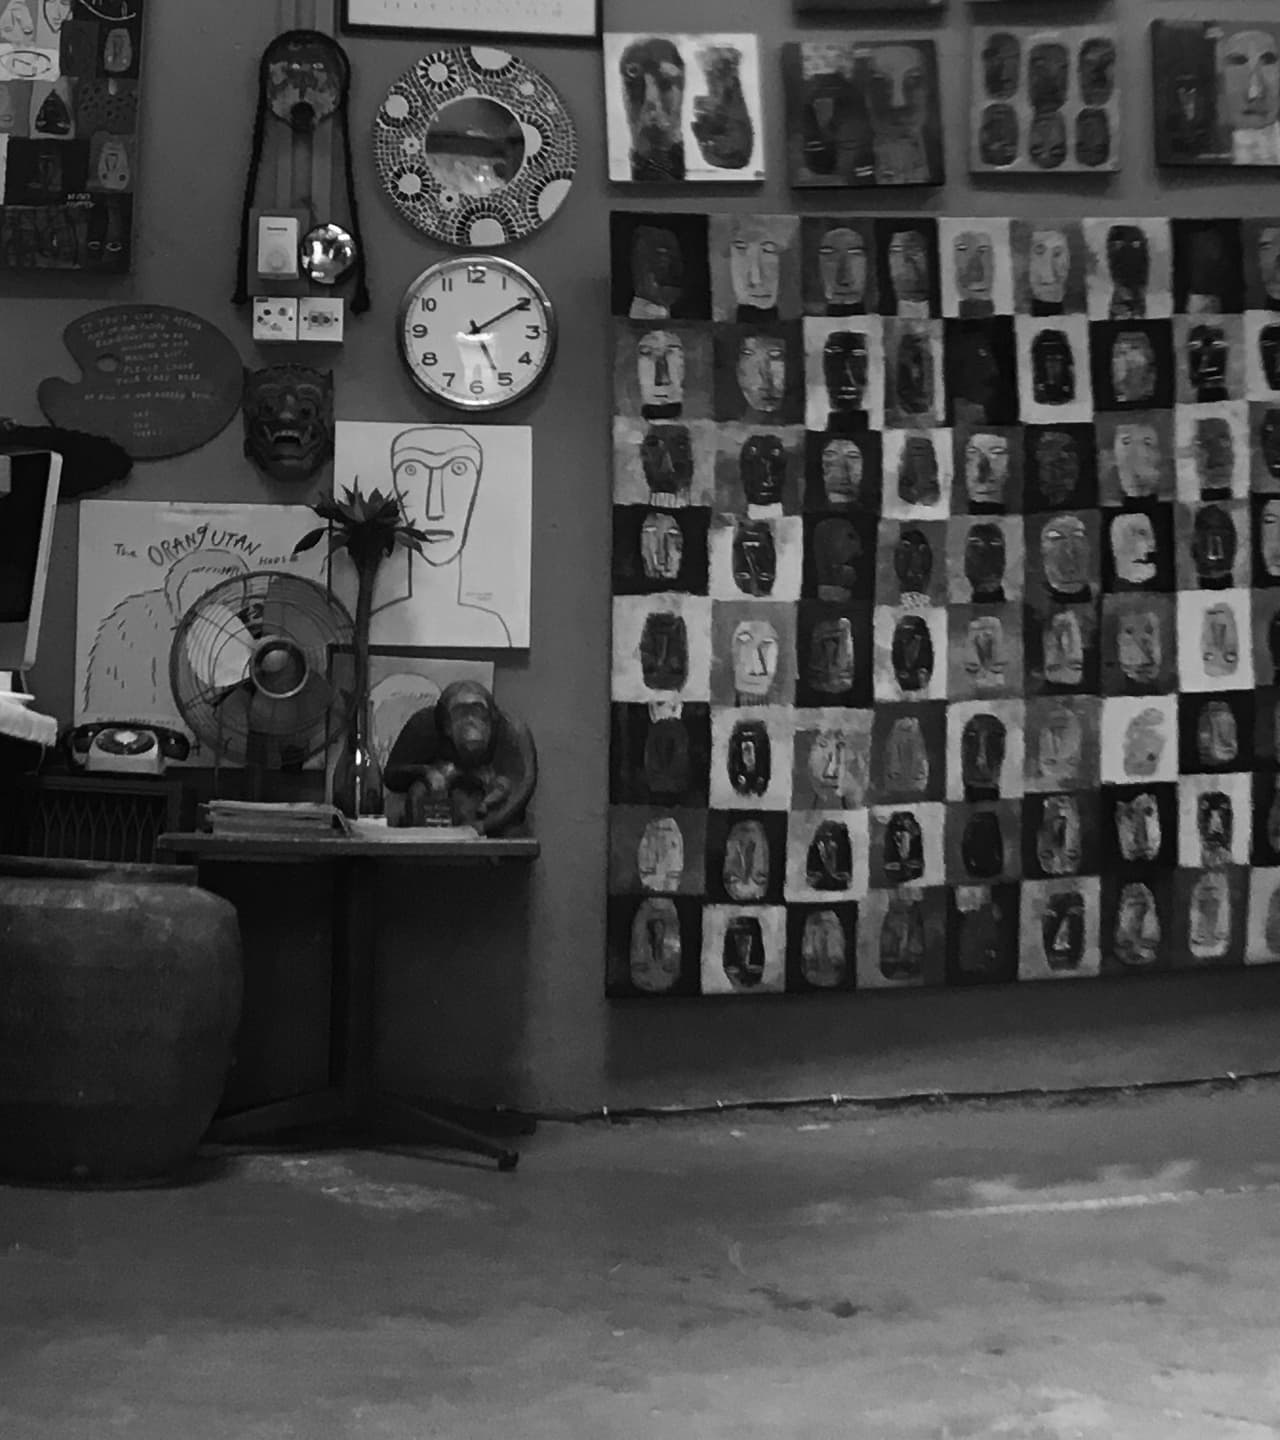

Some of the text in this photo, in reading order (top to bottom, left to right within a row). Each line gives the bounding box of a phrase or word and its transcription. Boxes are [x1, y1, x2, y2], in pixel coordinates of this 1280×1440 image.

[467, 269, 486, 284] 12
[441, 277, 453, 292] 11
[421, 297, 437, 312] 10
[517, 297, 531, 312] 2
[411, 324, 428, 339] 9
[525, 325, 541, 340] 3
[421, 351, 438, 366] 8
[517, 351, 533, 365] 4
[441, 372, 456, 387] 7
[497, 372, 513, 387] 5
[469, 380, 485, 395] 6
[113, 543, 138, 558] The
